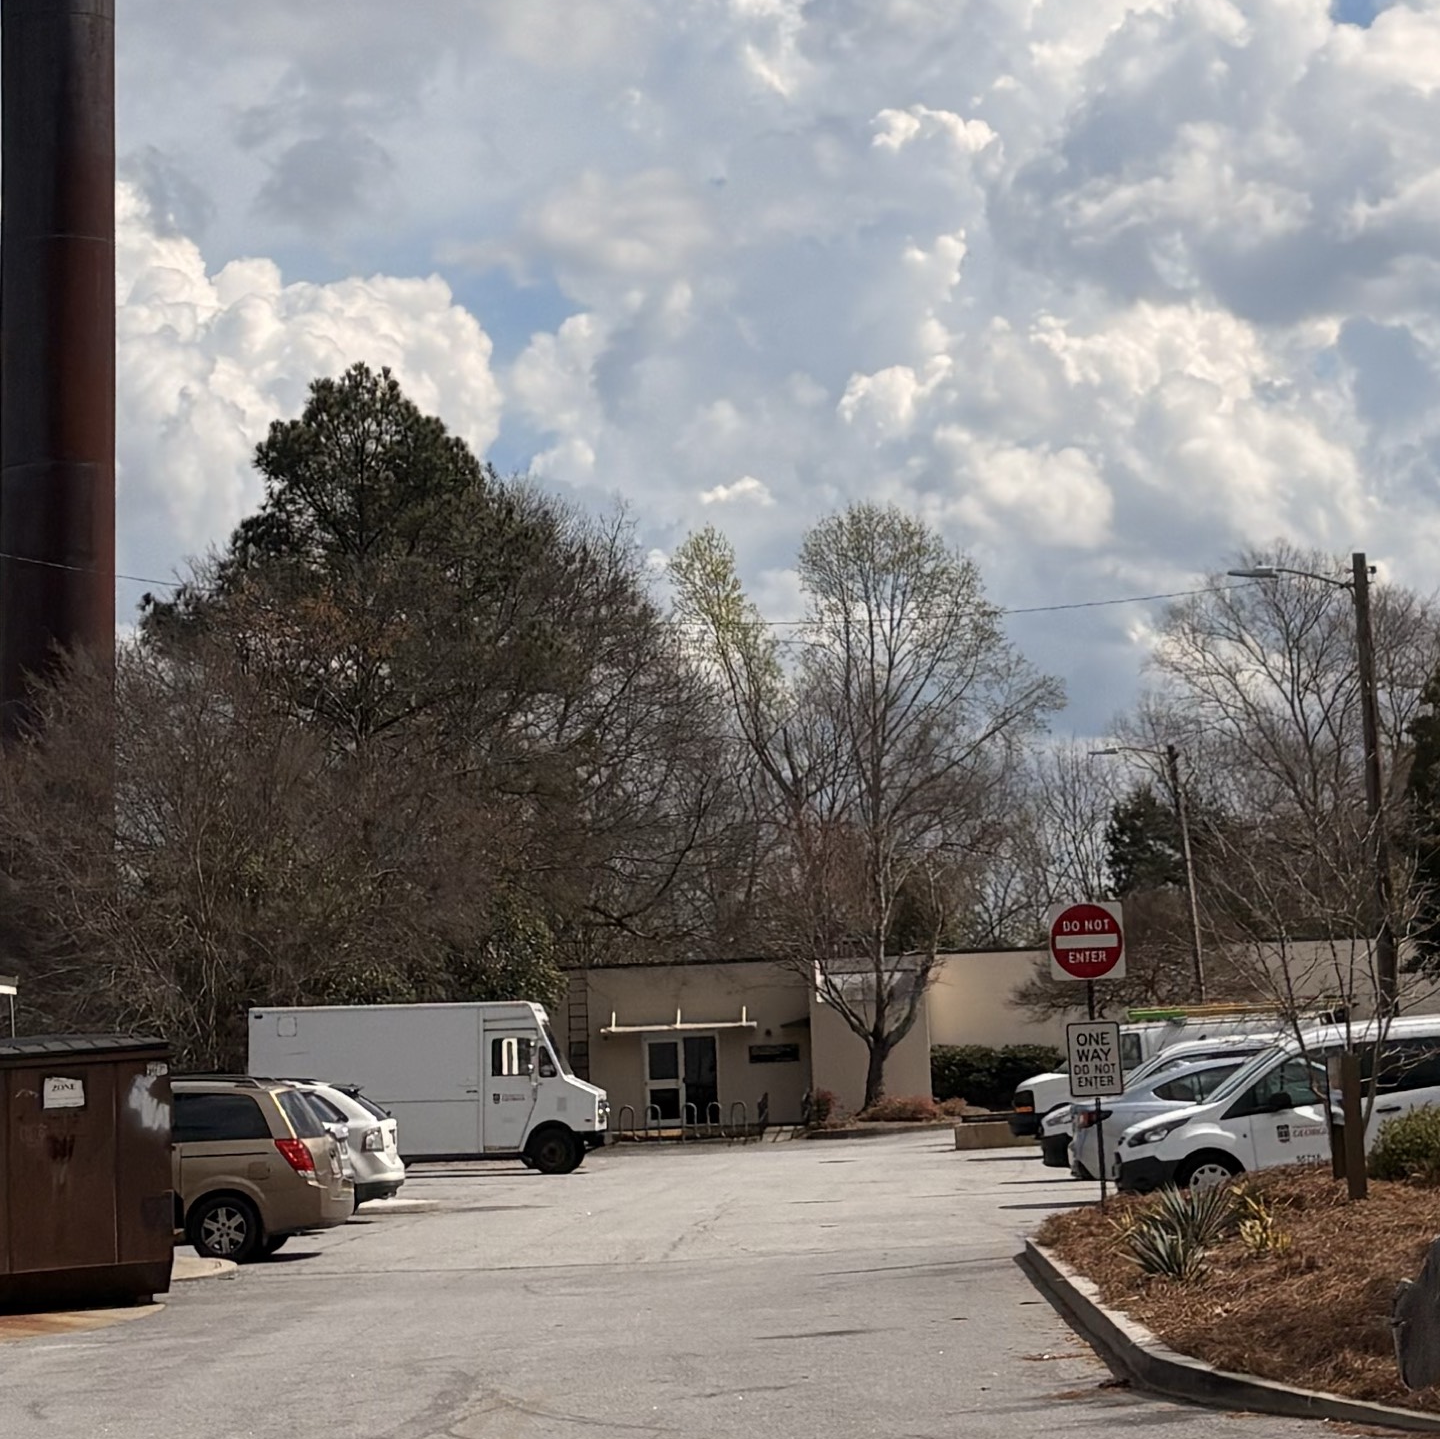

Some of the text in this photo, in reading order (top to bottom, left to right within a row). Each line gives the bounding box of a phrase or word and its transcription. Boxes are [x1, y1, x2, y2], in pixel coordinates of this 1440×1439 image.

[1062, 918, 1110, 932] DO NOT
[1068, 950, 1107, 964] ENTER
[1076, 1031, 1110, 1047] ONE
[1076, 1047, 1111, 1062] WAY
[1073, 1063, 1116, 1076] DO NOT
[1077, 1075, 1114, 1088] ENTER
